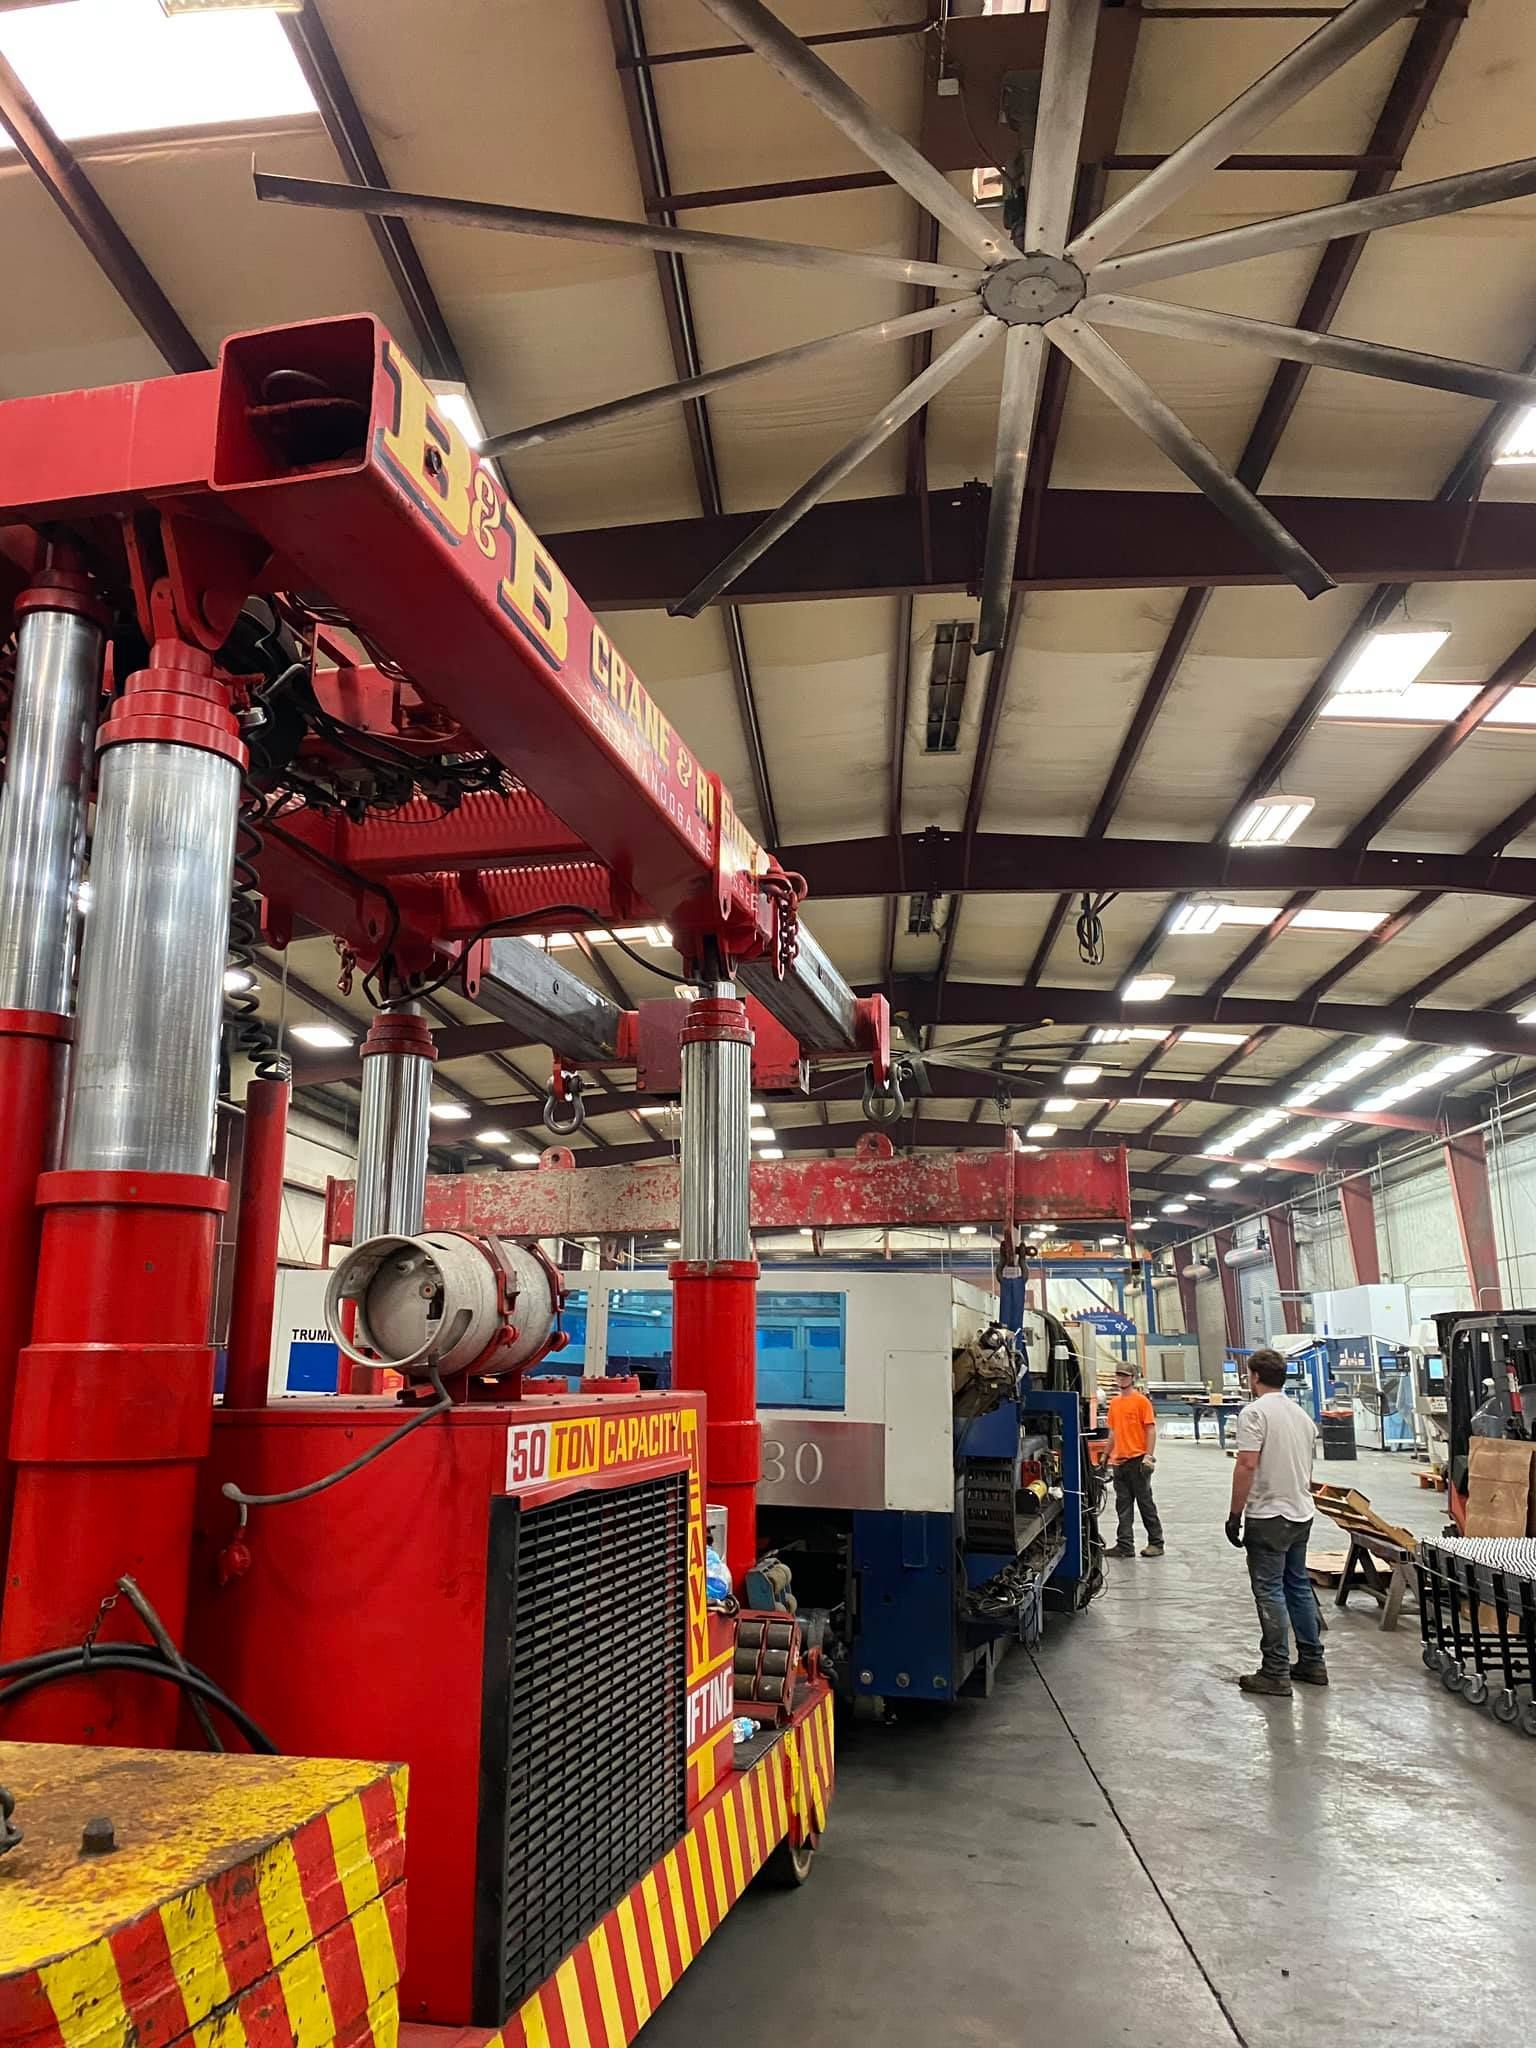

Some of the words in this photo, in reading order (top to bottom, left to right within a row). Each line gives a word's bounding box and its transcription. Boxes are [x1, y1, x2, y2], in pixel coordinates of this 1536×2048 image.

[590, 623, 670, 772] CRANE
[676, 746, 692, 788] &
[513, 1429, 547, 1482] 50
[555, 1422, 596, 1473] TON
[603, 1411, 681, 1466] CAPACITY
[682, 1428, 710, 1666] HEAVY
[687, 1666, 734, 1748] IFTING
